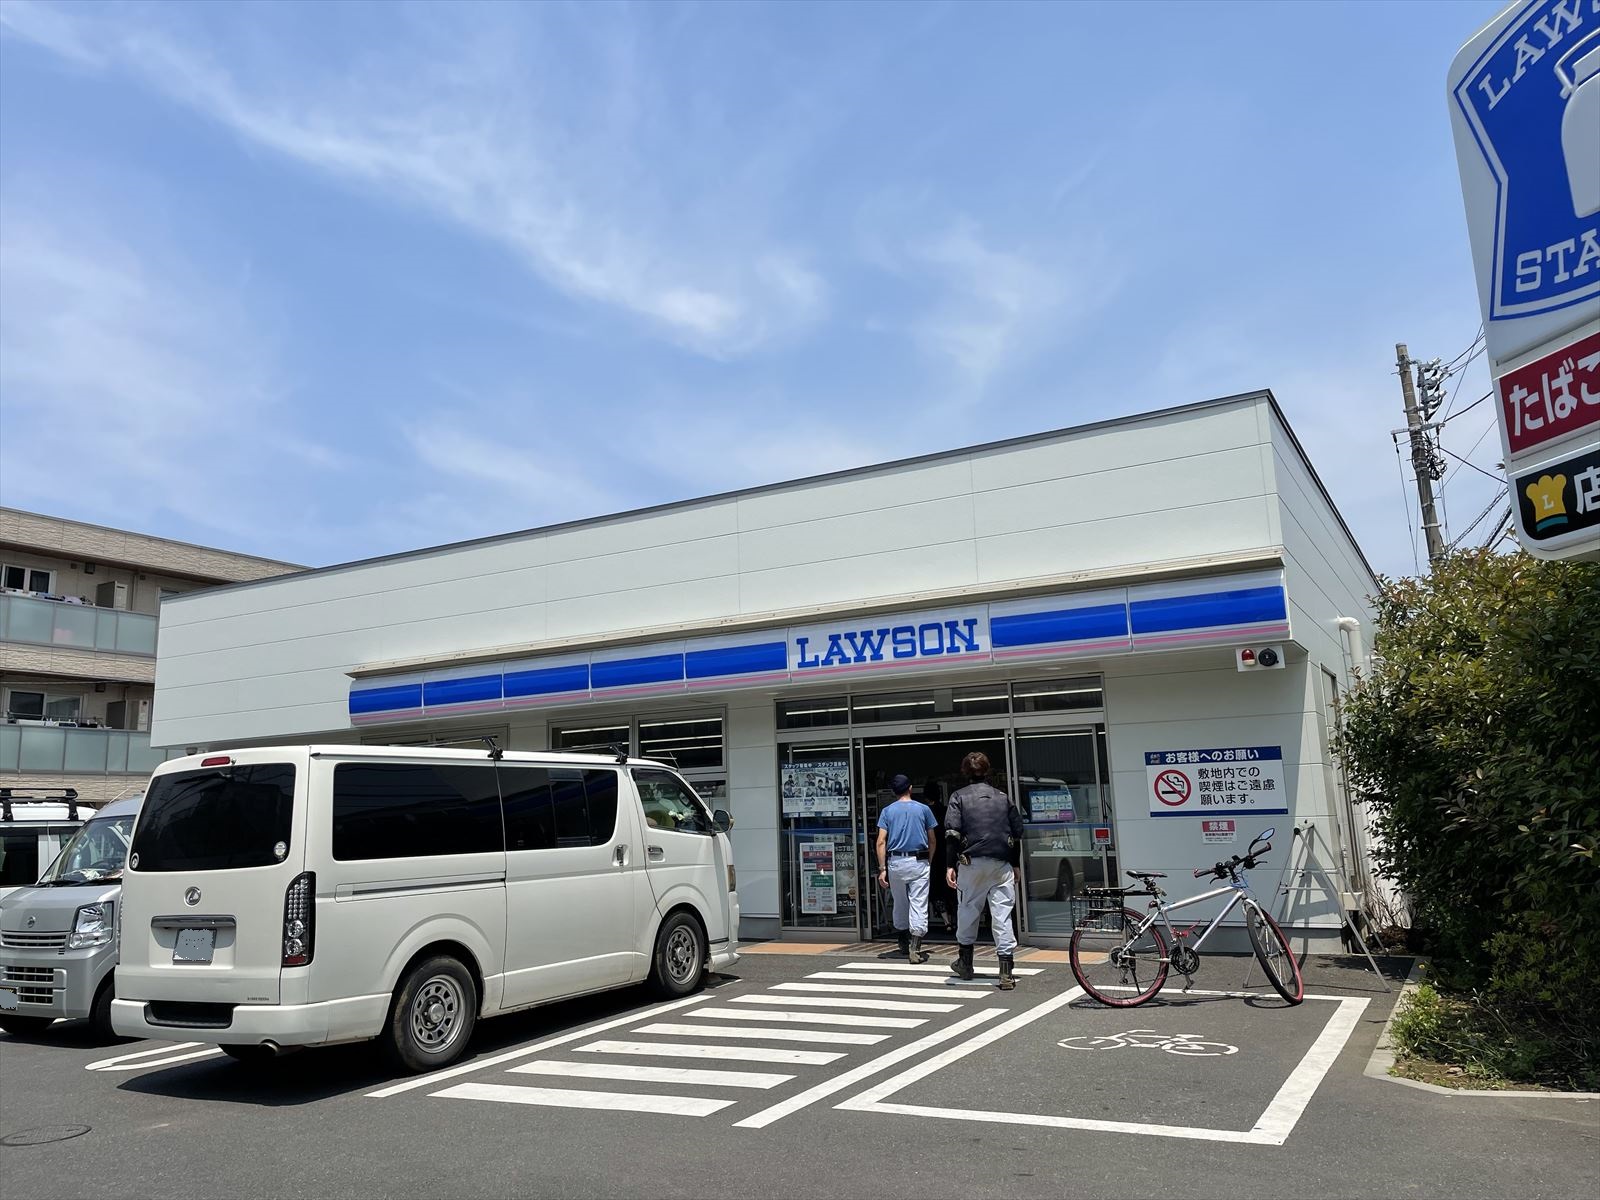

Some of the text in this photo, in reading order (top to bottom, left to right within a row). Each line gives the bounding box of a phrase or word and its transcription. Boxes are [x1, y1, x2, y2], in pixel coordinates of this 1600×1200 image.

[1478, 0, 1600, 111] LAW
[796, 618, 979, 668] LAWSON
[1165, 749, 1259, 764] お客様へのお願い
[1198, 766, 1260, 780] 敷地内での
[1199, 779, 1275, 793] 喫煙はご遠慮
[1200, 793, 1255, 806] 願います。
